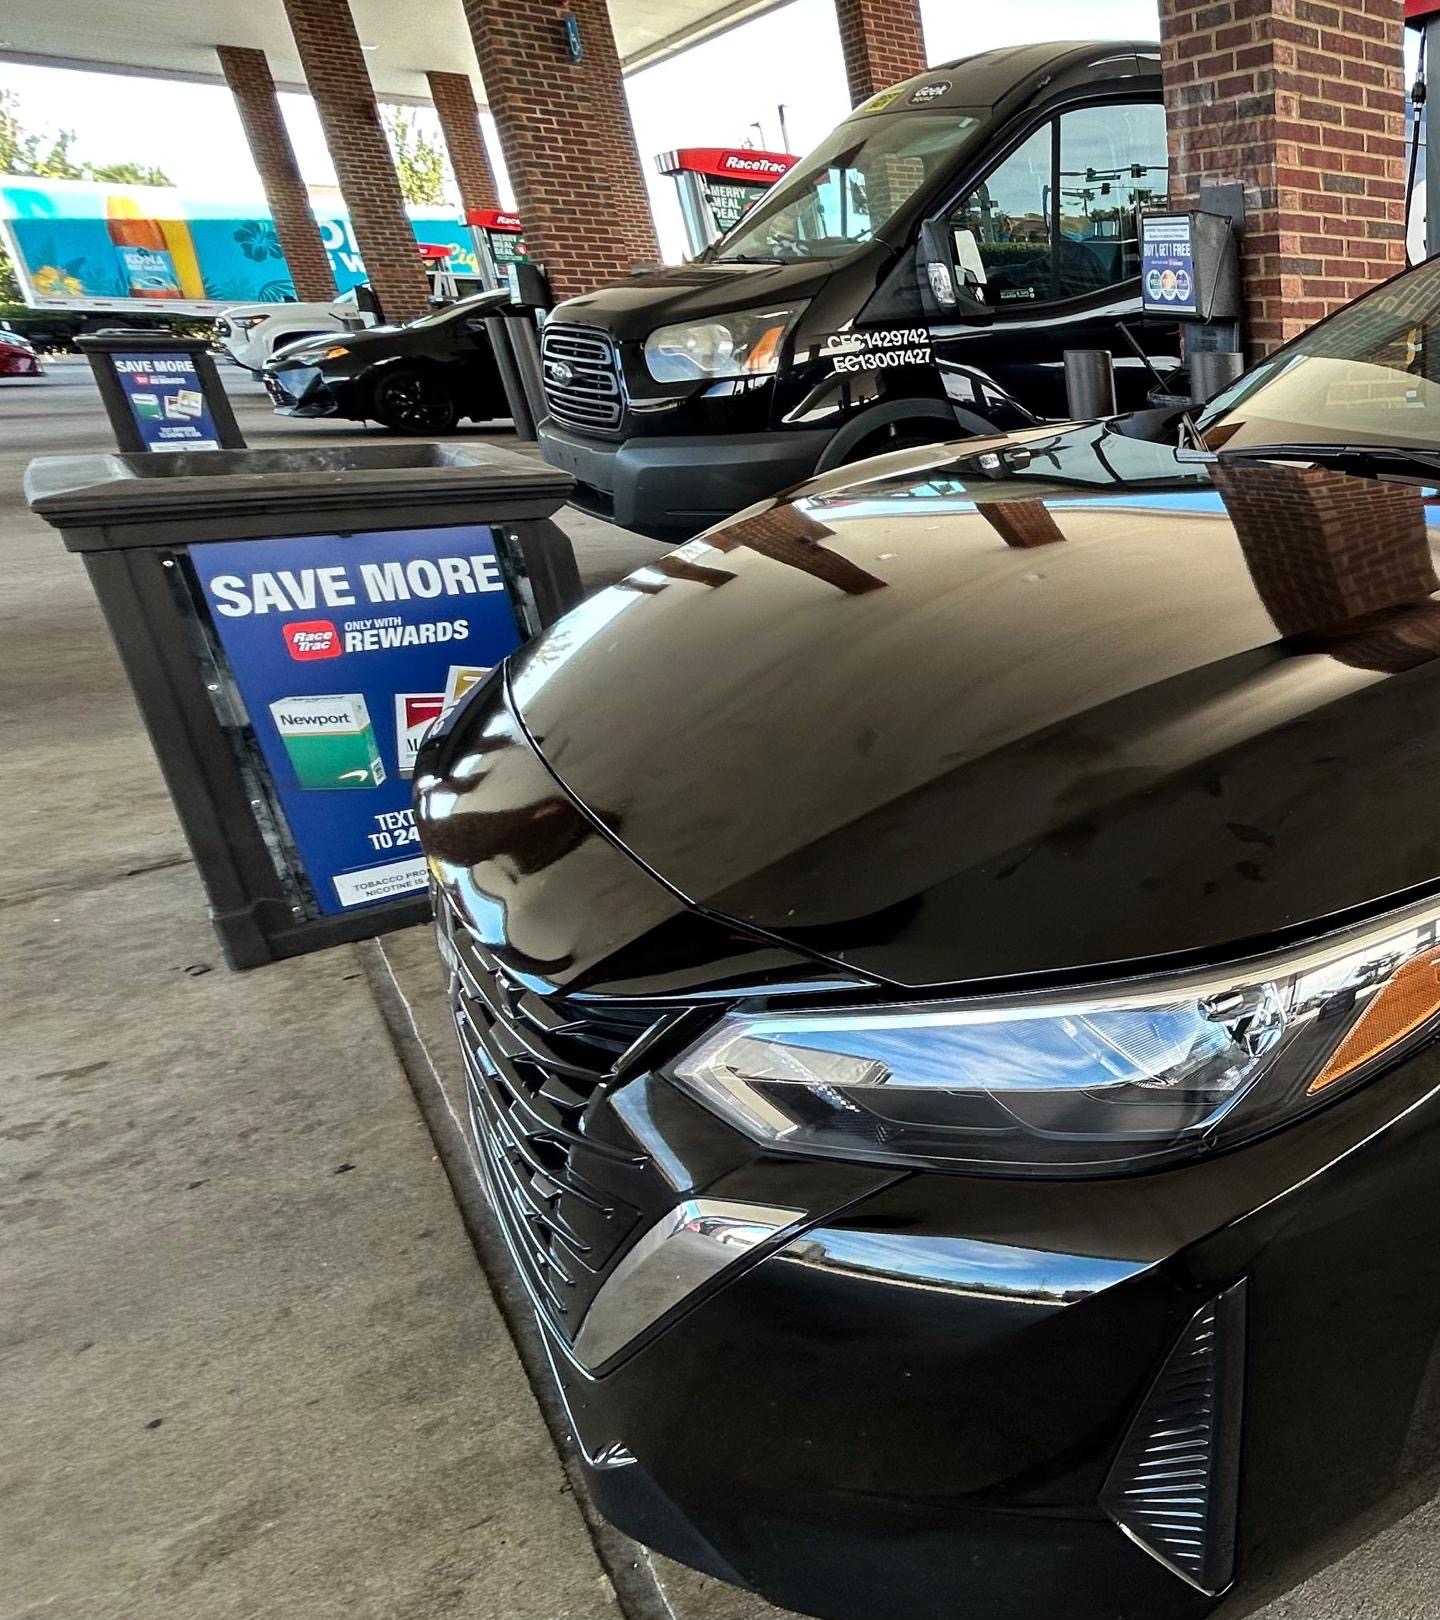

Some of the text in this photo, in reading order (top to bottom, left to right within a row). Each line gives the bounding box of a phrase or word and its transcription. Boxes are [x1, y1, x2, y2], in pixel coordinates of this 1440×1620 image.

[725, 156, 786, 172] RaceTrac
[710, 185, 746, 199] MERRY
[712, 197, 741, 209] MEAL
[712, 207, 740, 220] DEAL
[1173, 243, 1191, 257] FREE
[114, 360, 196, 372] SAVE MORE
[833, 348, 931, 373] EC13007427
[209, 554, 504, 618] SAVE MORE
[344, 616, 401, 631] ONLY WITH
[292, 630, 333, 644] Race
[345, 619, 469, 653] REWARDS
[298, 640, 331, 652] Trac
[280, 712, 351, 727] Newport
[374, 809, 416, 831] TEXT
[368, 832, 393, 850] TO
[353, 874, 404, 891] TOBACCO
[366, 881, 411, 897] NICOTINE
